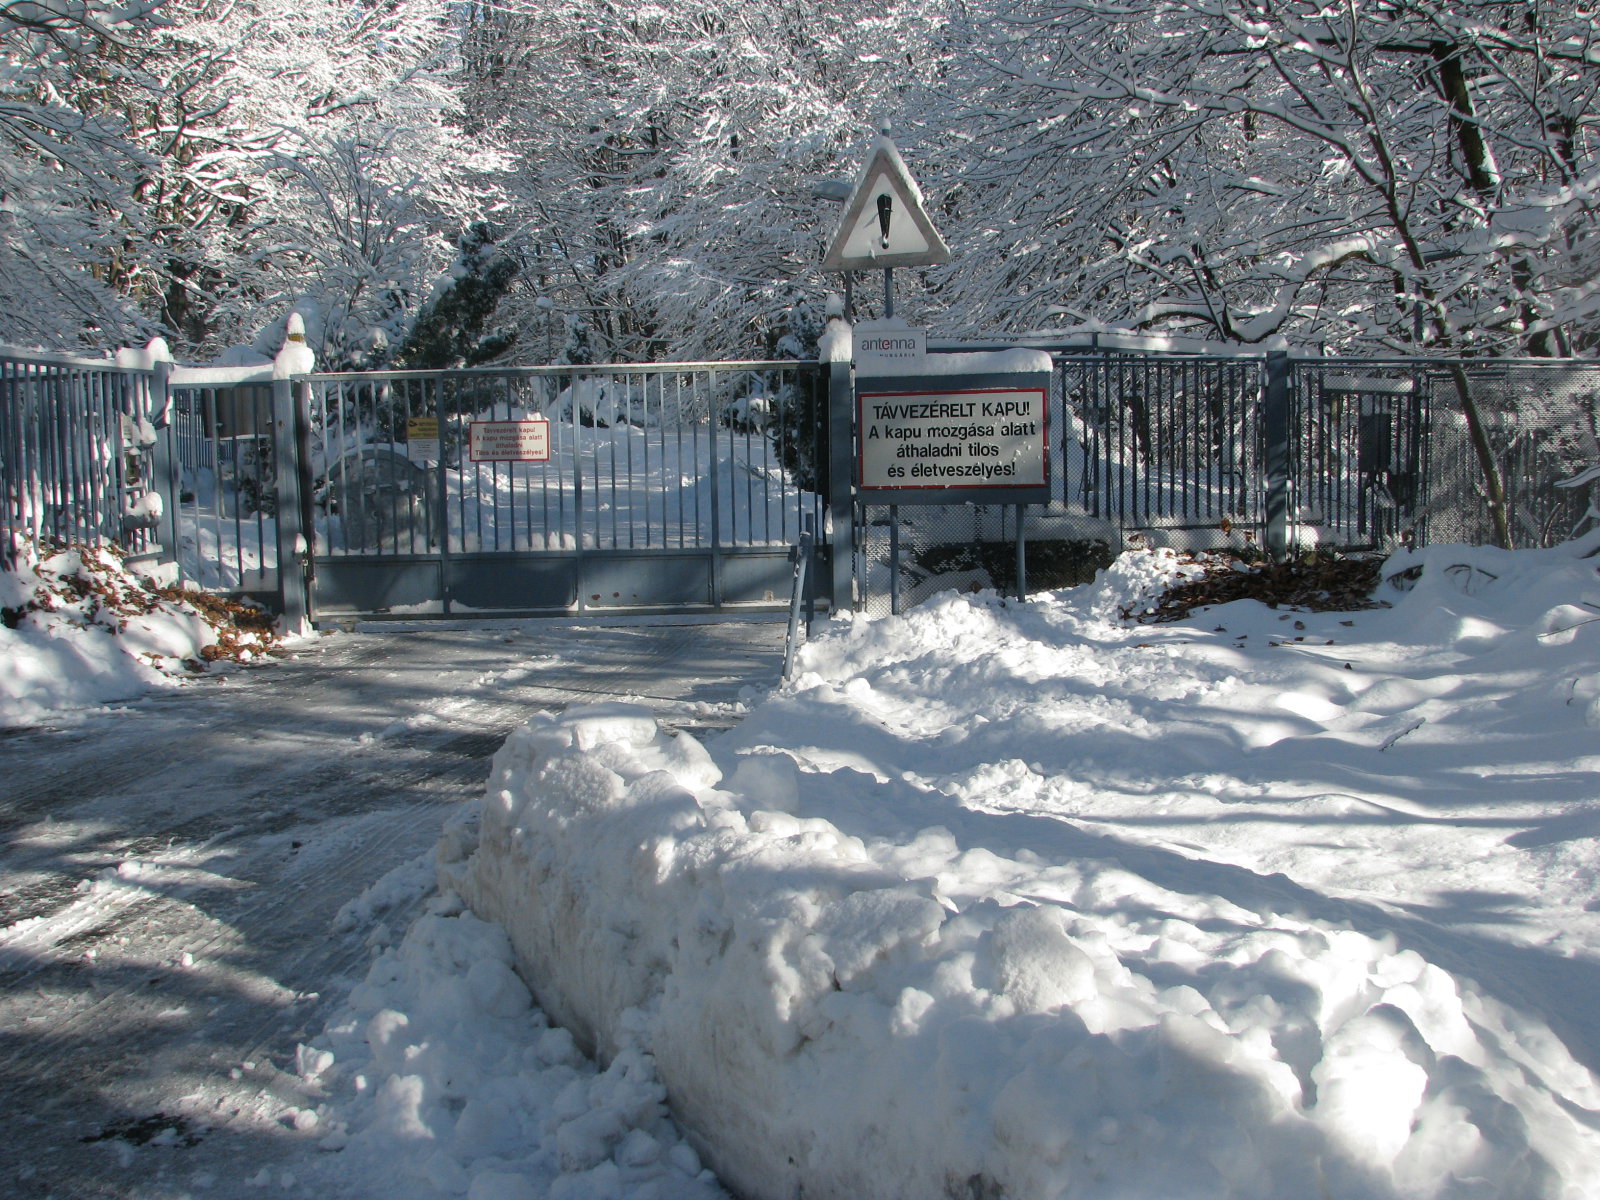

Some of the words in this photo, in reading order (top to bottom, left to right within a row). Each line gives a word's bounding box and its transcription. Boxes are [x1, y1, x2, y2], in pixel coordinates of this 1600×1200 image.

[862, 338, 916, 350] antenna
[873, 400, 976, 419] TÁVVEZÉRELT
[982, 402, 1030, 416] KAPU!
[869, 426, 879, 439] A
[885, 425, 921, 442] kapu
[928, 423, 994, 440] mozgása
[1000, 422, 1036, 436] alatt
[896, 444, 962, 458] áthaladni
[968, 443, 999, 456] tilos
[888, 464, 904, 478] és
[911, 462, 1015, 479] életveszélyes!
